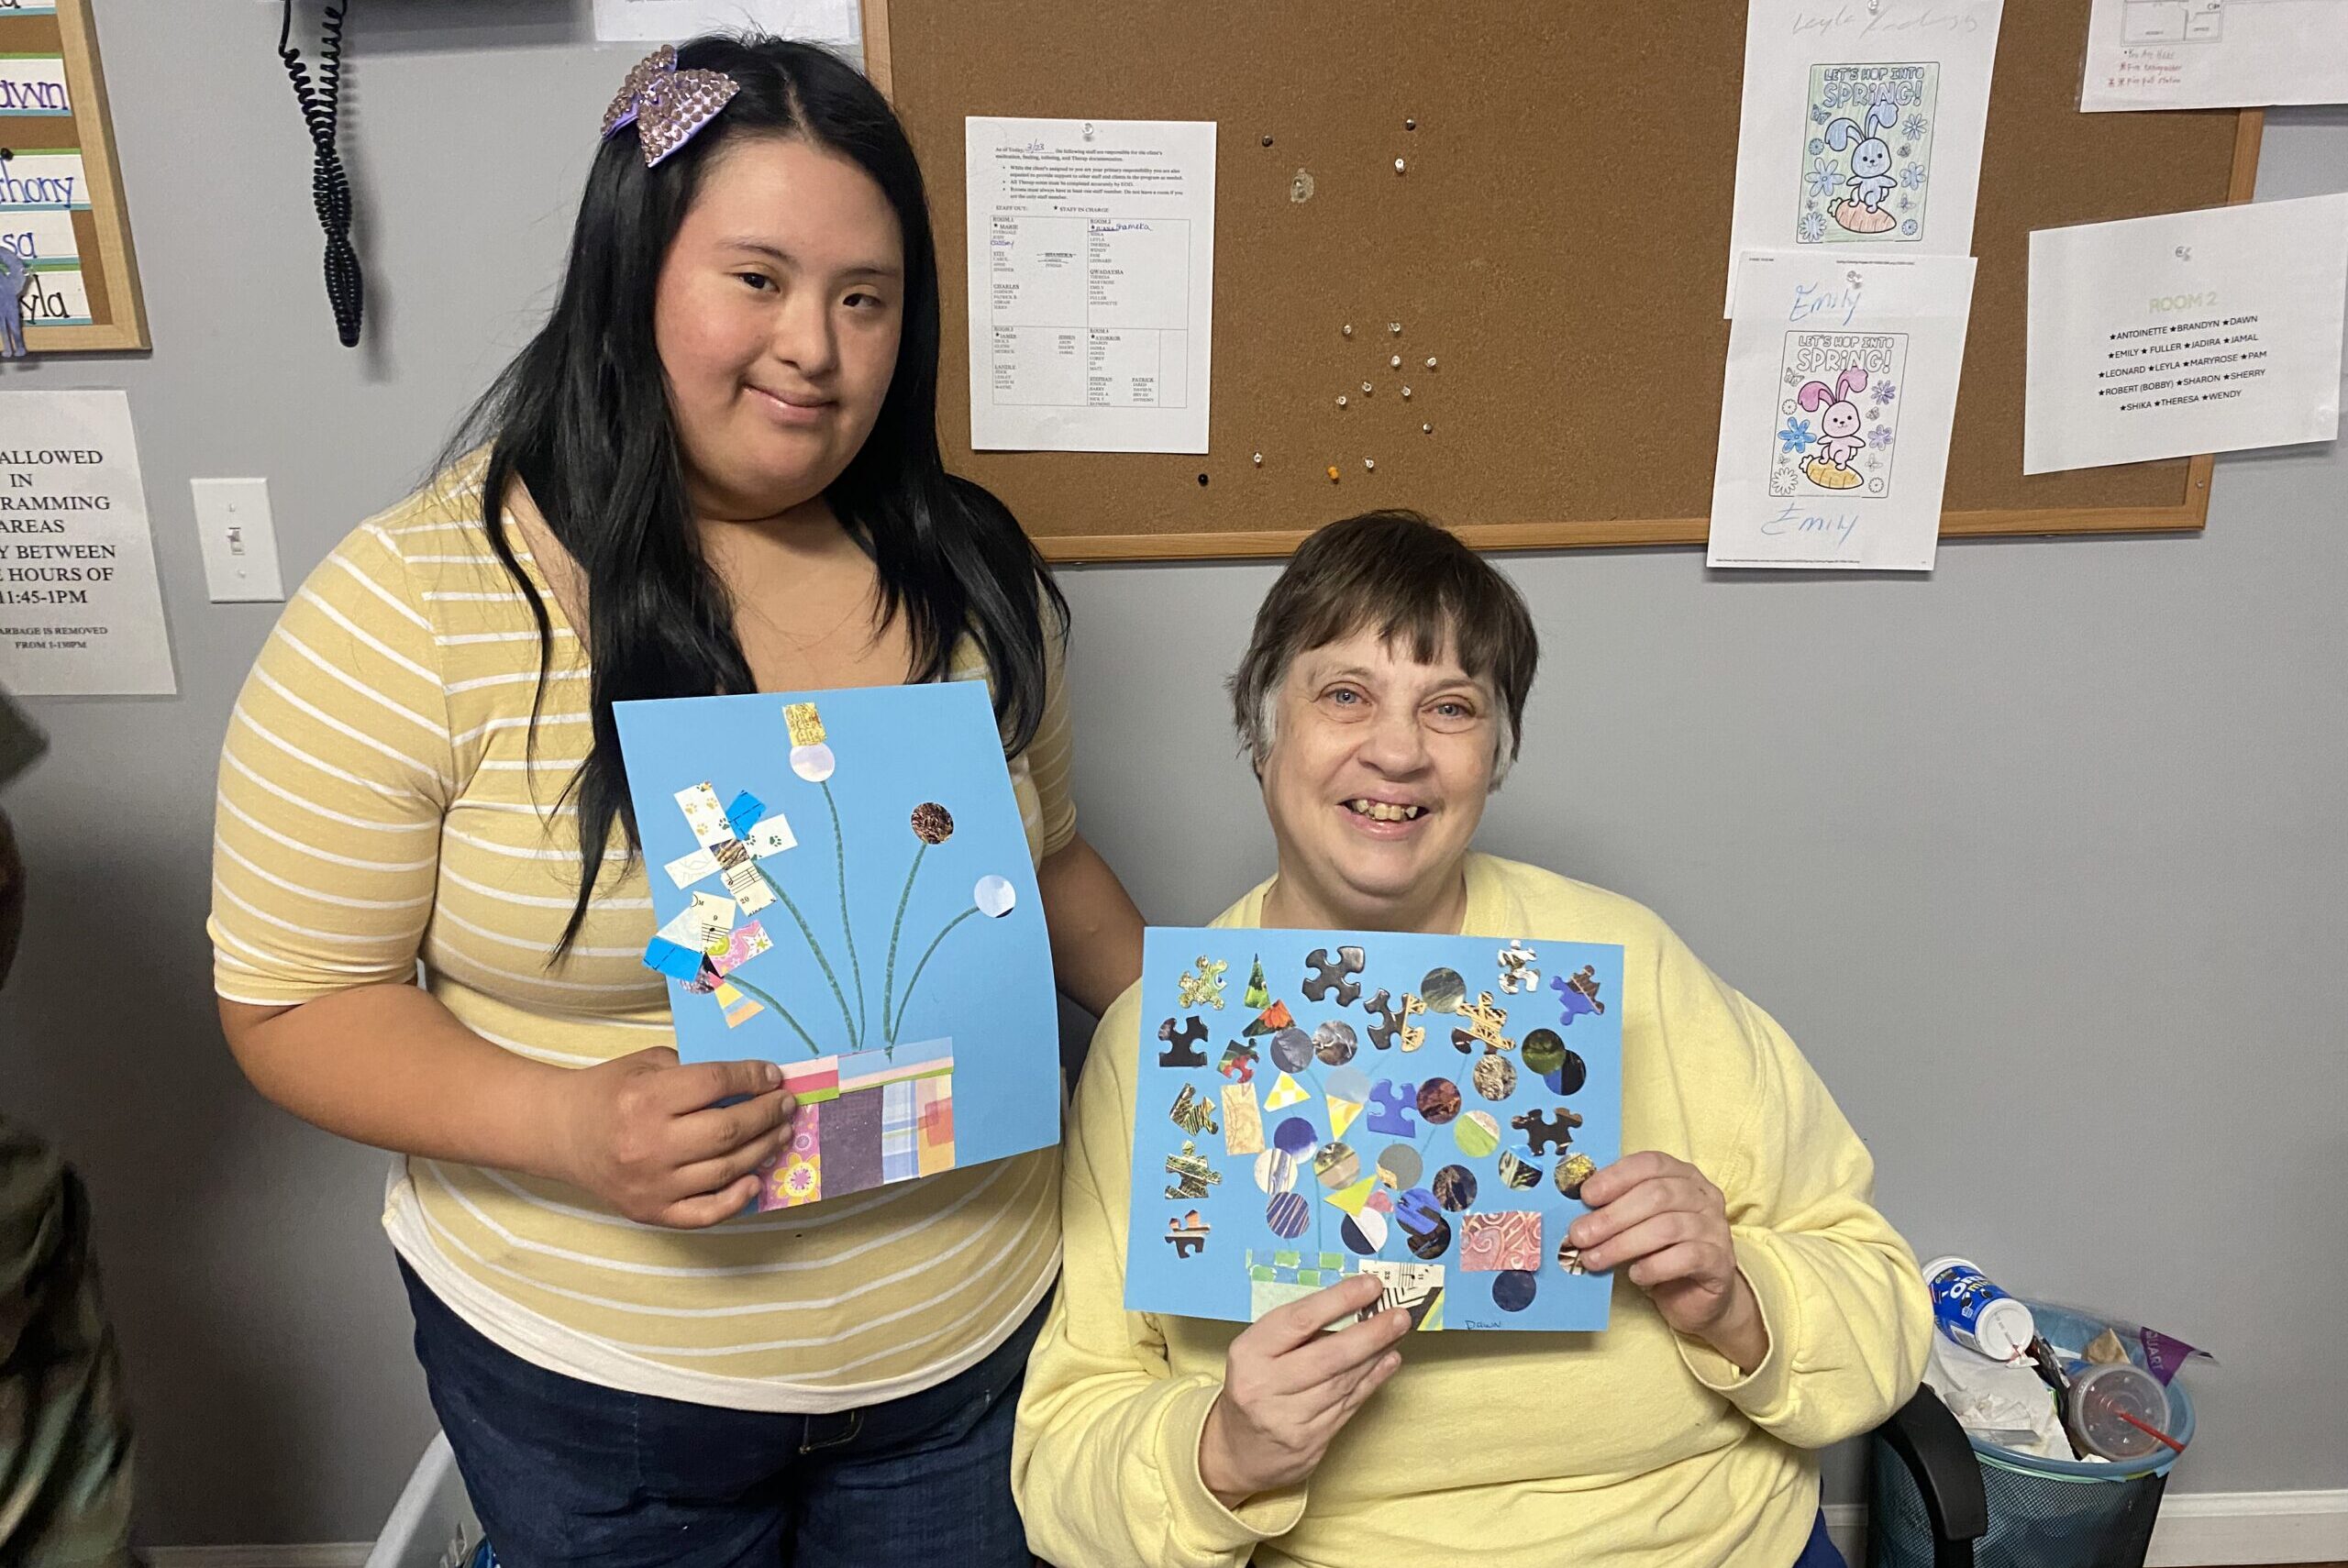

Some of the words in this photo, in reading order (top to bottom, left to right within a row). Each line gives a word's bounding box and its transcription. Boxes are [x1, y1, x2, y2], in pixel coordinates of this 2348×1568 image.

[1824, 68, 1859, 81] LET'S
[1861, 67, 1888, 81] HOP
[1890, 66, 1924, 80] INTO
[0, 157, 74, 208] hony
[1789, 282, 1862, 326] Emily
[2148, 294, 2201, 314] ROOM
[2207, 292, 2218, 307] 2
[2116, 326, 2167, 340] ANTOINETTE
[2176, 320, 2220, 332] BRANDYN
[2230, 315, 2258, 326] DAWN
[1799, 335, 1831, 348] LET'S
[1834, 336, 1860, 348] HOP
[1863, 337, 1894, 349] INTO
[2115, 348, 2139, 359] EMILY
[2150, 343, 2182, 354] FULLER
[2190, 337, 2221, 349] JADIRA
[2230, 334, 2259, 344] JAMAL
[2105, 365, 2146, 378] LEONARD
[2154, 361, 2180, 371] LEYLA
[2190, 354, 2238, 367] MARYROSE
[2248, 350, 2267, 359] PAM
[2105, 384, 2139, 396] ROBERT
[2140, 381, 2174, 392] (BOBBY)
[2183, 375, 2221, 386] SHARON
[2230, 369, 2265, 381] SHERRY
[2126, 401, 2152, 411] SHIKA
[2161, 395, 2199, 406] THERESA
[2209, 390, 2242, 401] WENDY
[0, 449, 104, 465] ALLOWED
[8, 473, 33, 488] IN
[0, 519, 65, 533] AREAS
[16, 545, 116, 559] BETWEEN
[7, 567, 83, 581] HOURS
[87, 567, 115, 581] OF
[43, 626, 53, 635] IS
[55, 626, 108, 635] REMOVED
[15, 641, 46, 649] FROM
